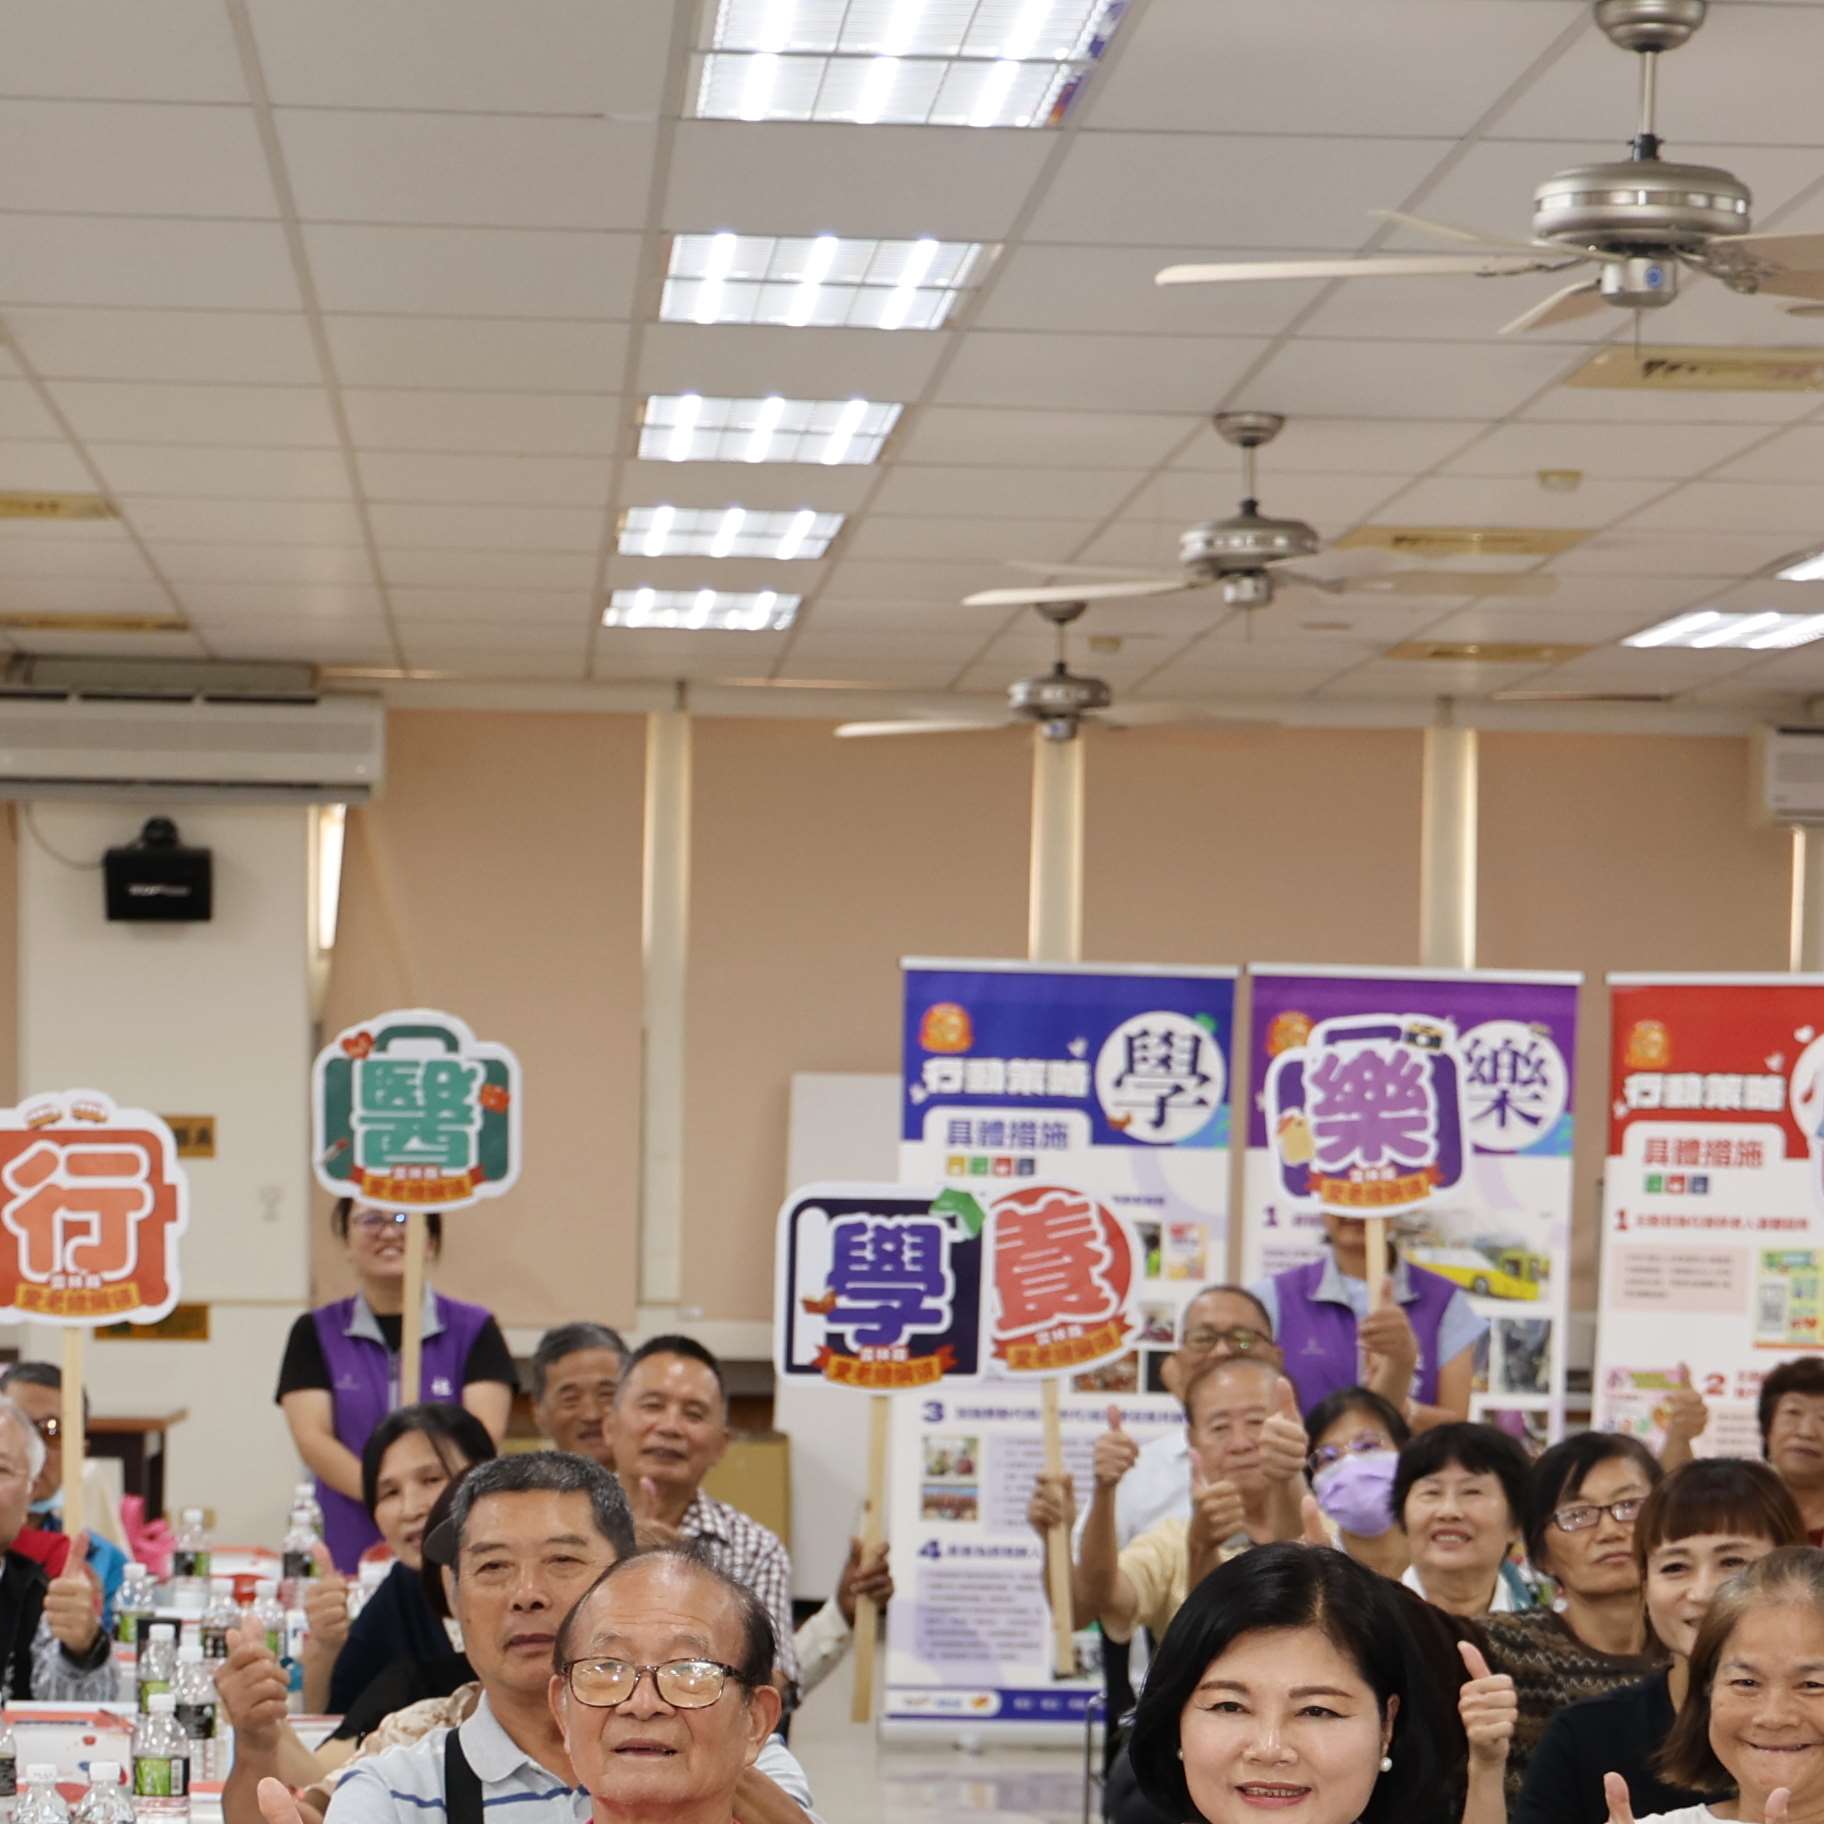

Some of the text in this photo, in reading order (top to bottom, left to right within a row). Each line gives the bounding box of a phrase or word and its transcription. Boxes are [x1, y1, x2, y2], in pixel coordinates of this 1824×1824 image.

[354, 1058, 483, 1171] 醫
[1115, 1029, 1211, 1130] 學
[1311, 1049, 1434, 1166] 樂
[1464, 1037, 1550, 1129] 樂
[4, 1141, 153, 1280] 行
[825, 1214, 953, 1349] 學
[924, 1402, 946, 1422] 3
